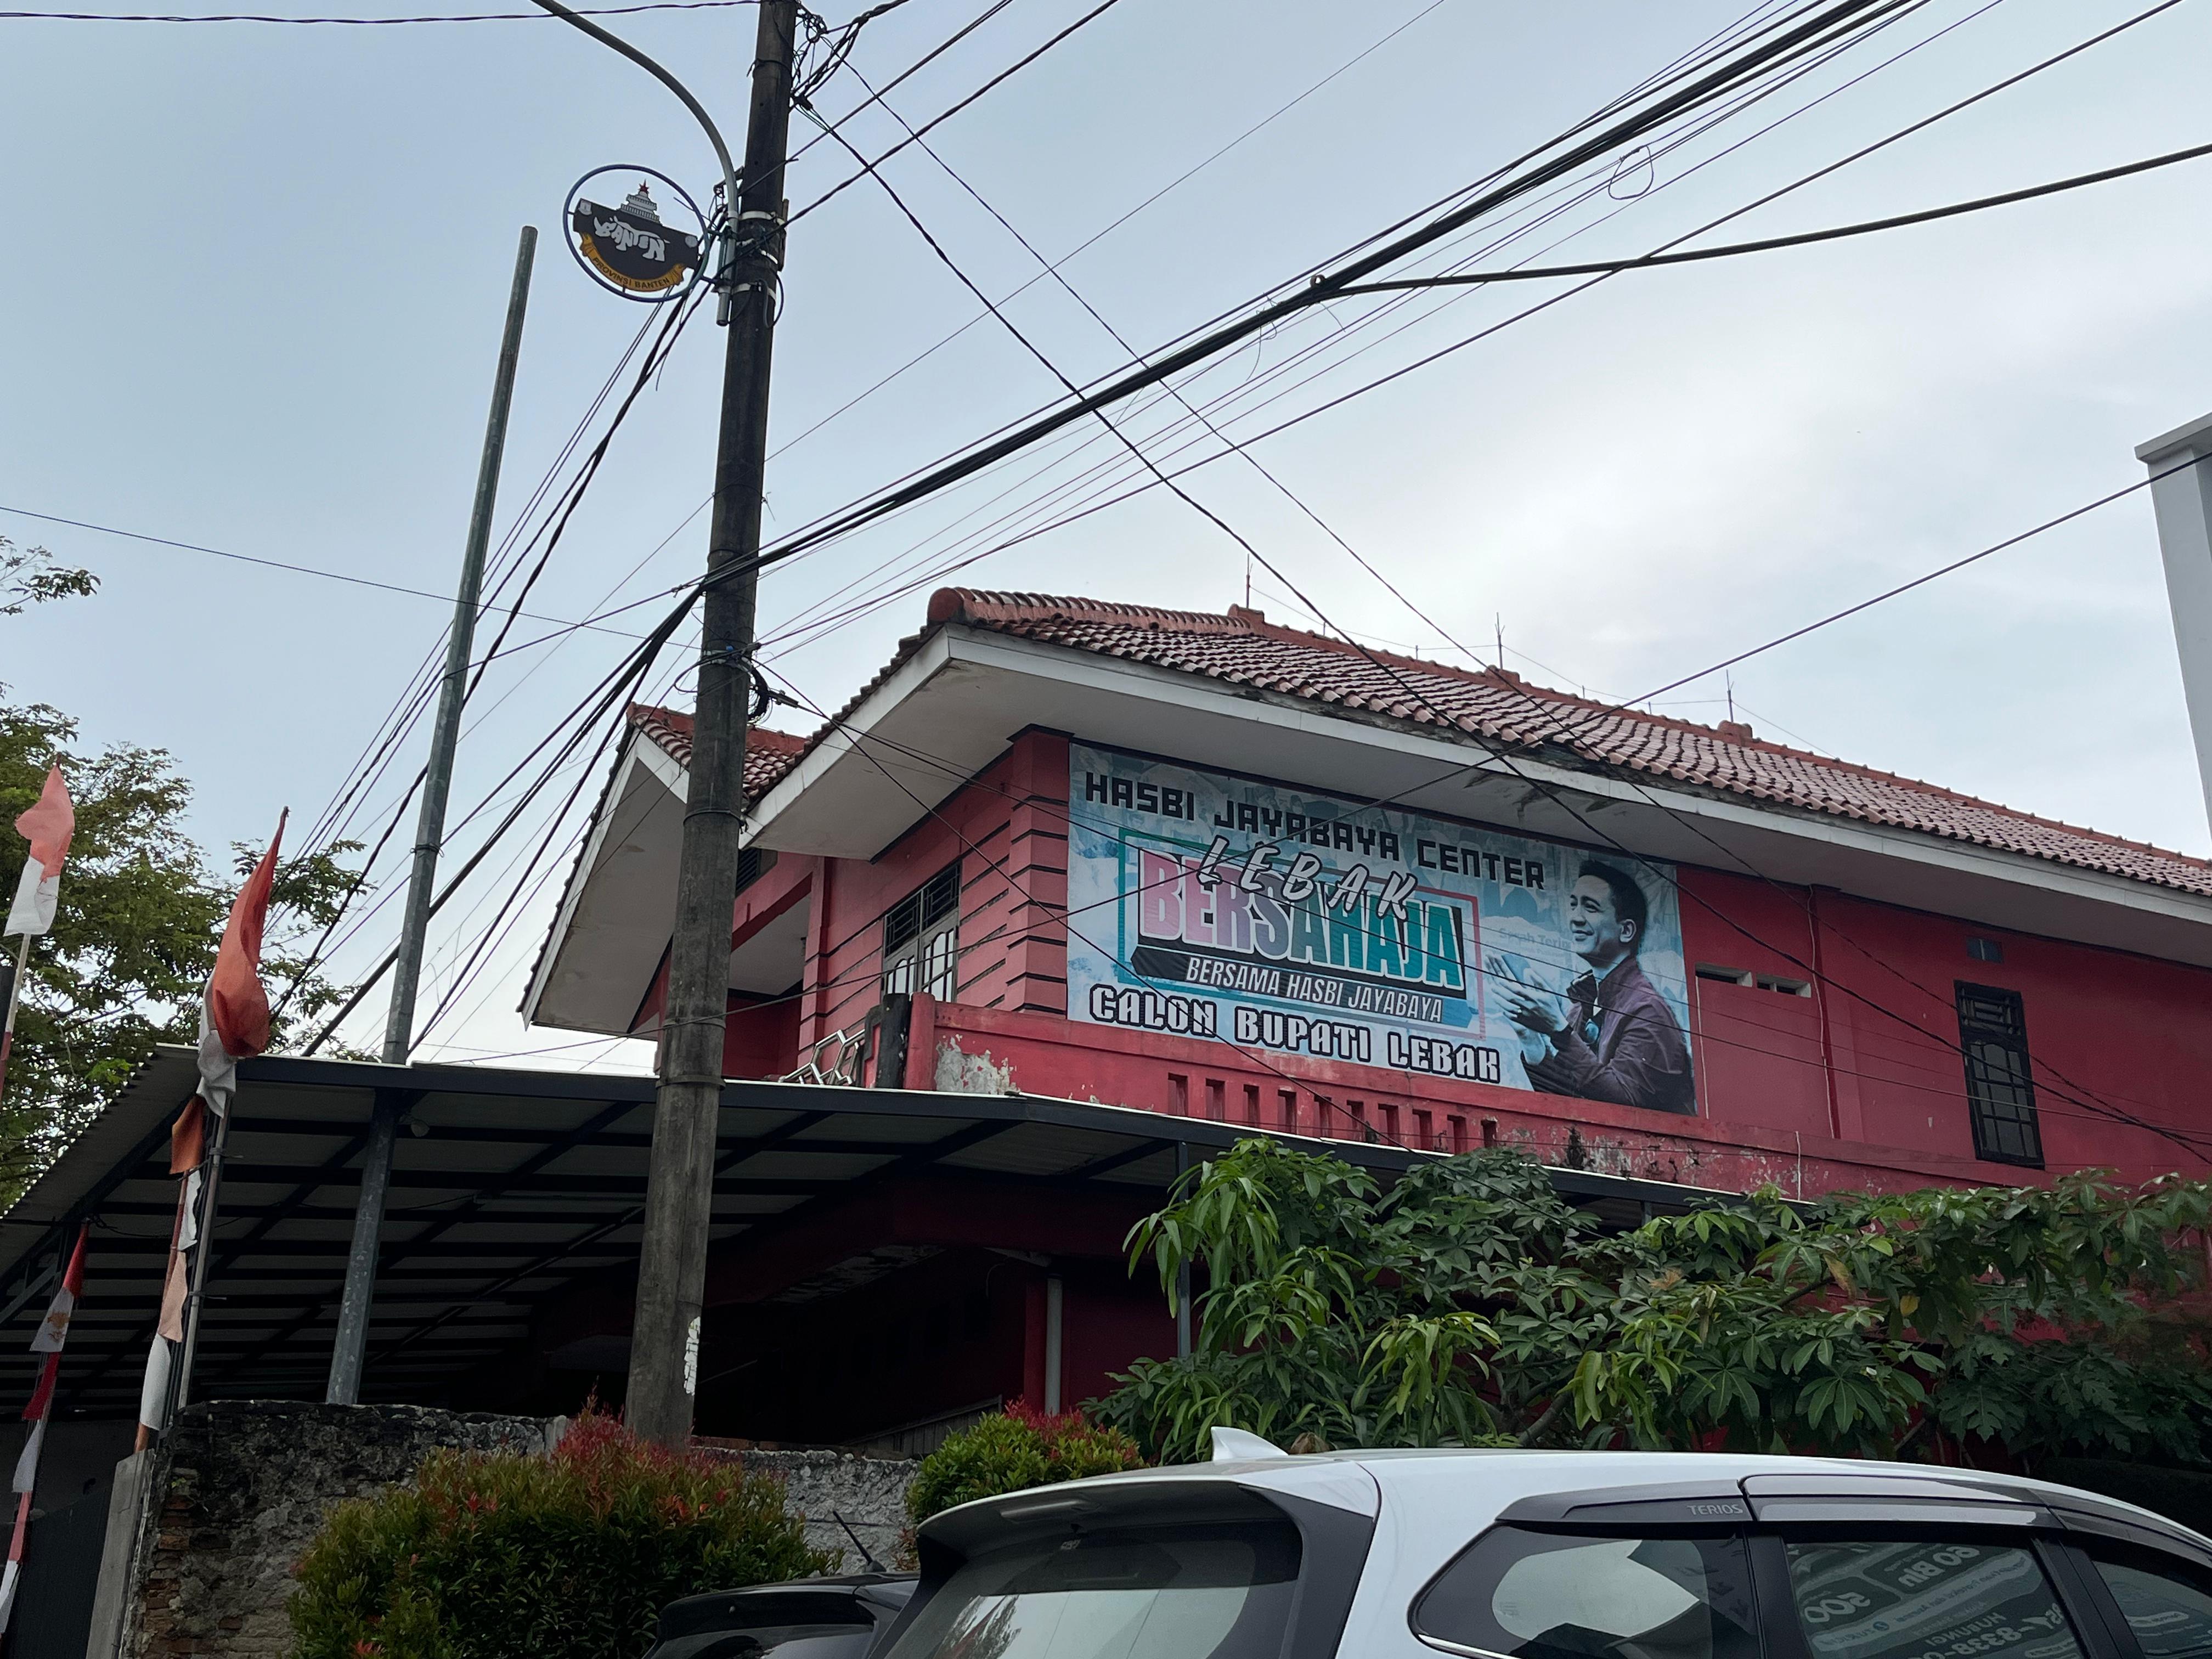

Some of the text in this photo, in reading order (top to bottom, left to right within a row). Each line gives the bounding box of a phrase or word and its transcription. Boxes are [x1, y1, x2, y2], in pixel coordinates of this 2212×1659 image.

[593, 258, 670, 289] PROVINSI BANTEN
[1085, 771, 1545, 890] HASBI JAYABAYA CENTER
[1197, 834, 1418, 921] LEBAK
[1187, 957, 1443, 1024] BERSAMA HASBI JAYABAYA
[1091, 984, 1501, 1084] CALON BUPATI LEBAK
[1686, 1504, 1743, 1515] TERIOS
